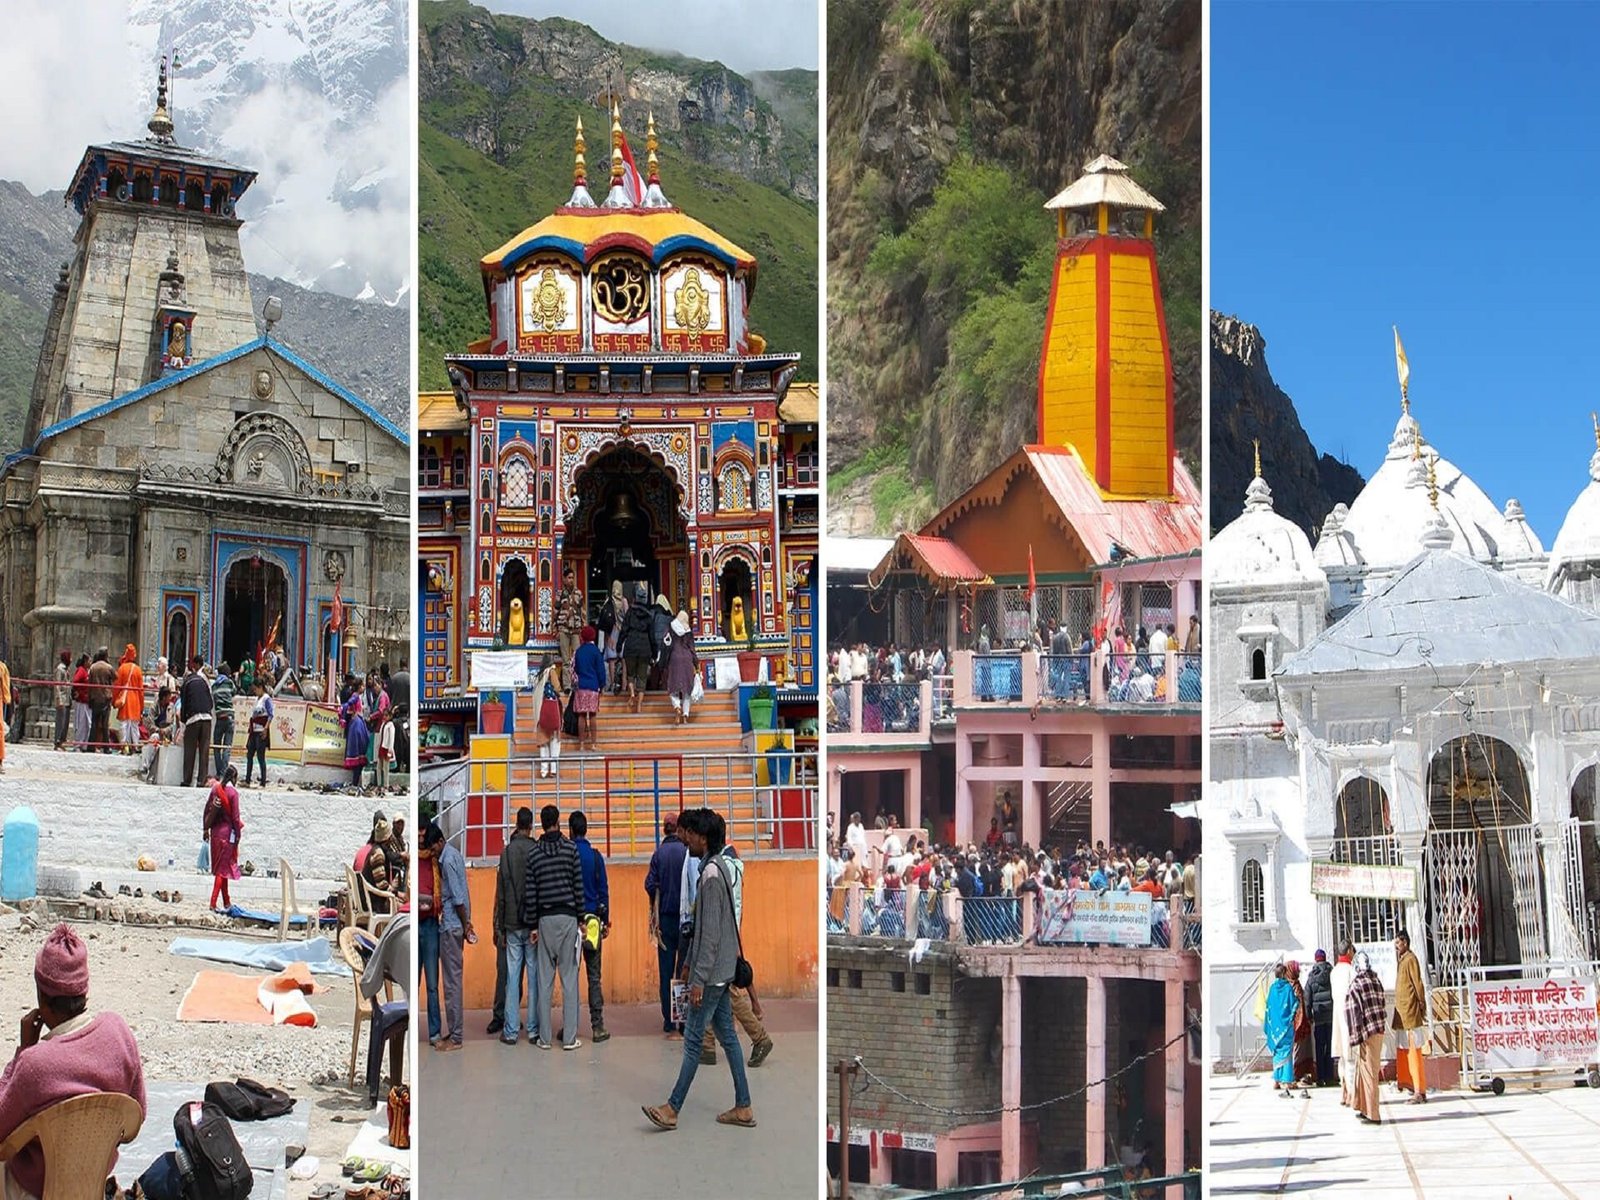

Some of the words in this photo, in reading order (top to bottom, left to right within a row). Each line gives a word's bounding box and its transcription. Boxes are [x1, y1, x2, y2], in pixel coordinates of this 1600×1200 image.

[1475, 991, 1499, 1011] मुख्य
[1499, 986, 1512, 1005] श्री
[1513, 986, 1533, 1006] गंगा
[1570, 980, 1585, 1001] के
[1505, 1012, 1511, 1025] 2
[1538, 1011, 1544, 1025] 3
